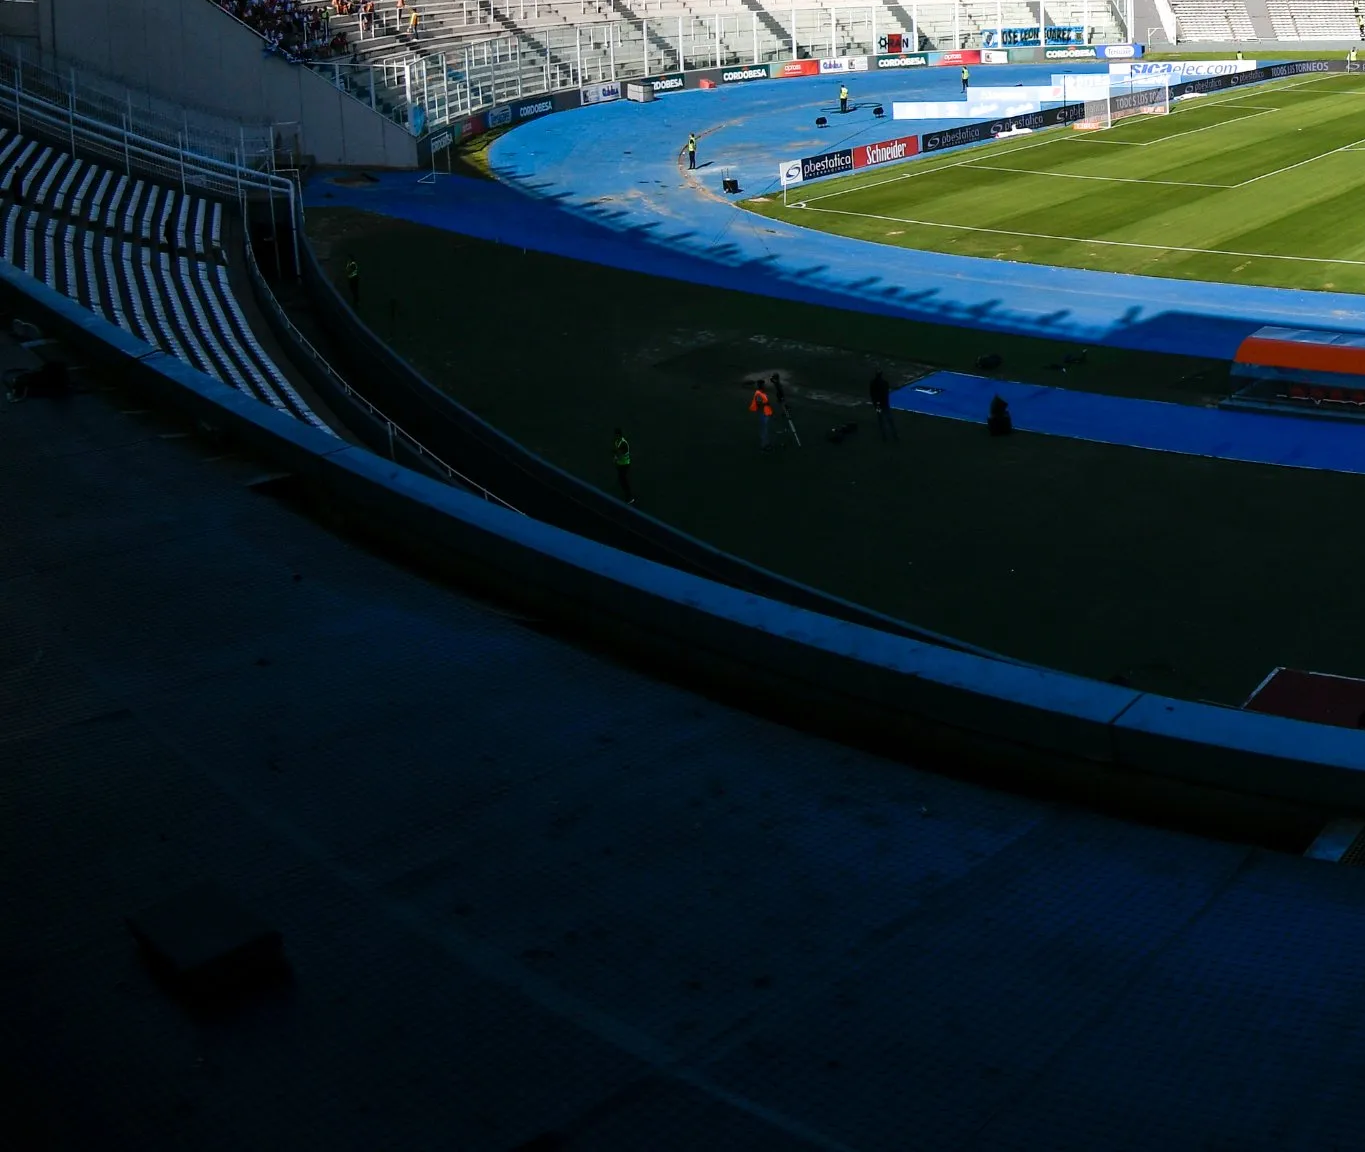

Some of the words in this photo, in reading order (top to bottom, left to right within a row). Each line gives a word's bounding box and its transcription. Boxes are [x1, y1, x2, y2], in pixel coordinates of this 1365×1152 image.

[878, 56, 927, 68] CORDOBESA
[1046, 48, 1096, 59] CORDOBESA
[723, 68, 767, 81] CORDOBESA
[1270, 65, 1287, 78] TODOS
[1287, 64, 1298, 75] LOS
[1298, 61, 1329, 75] TORNEOS
[519, 100, 553, 117] CORDOBESA
[866, 141, 907, 165] Schneider
[803, 153, 852, 177] pbestatica
